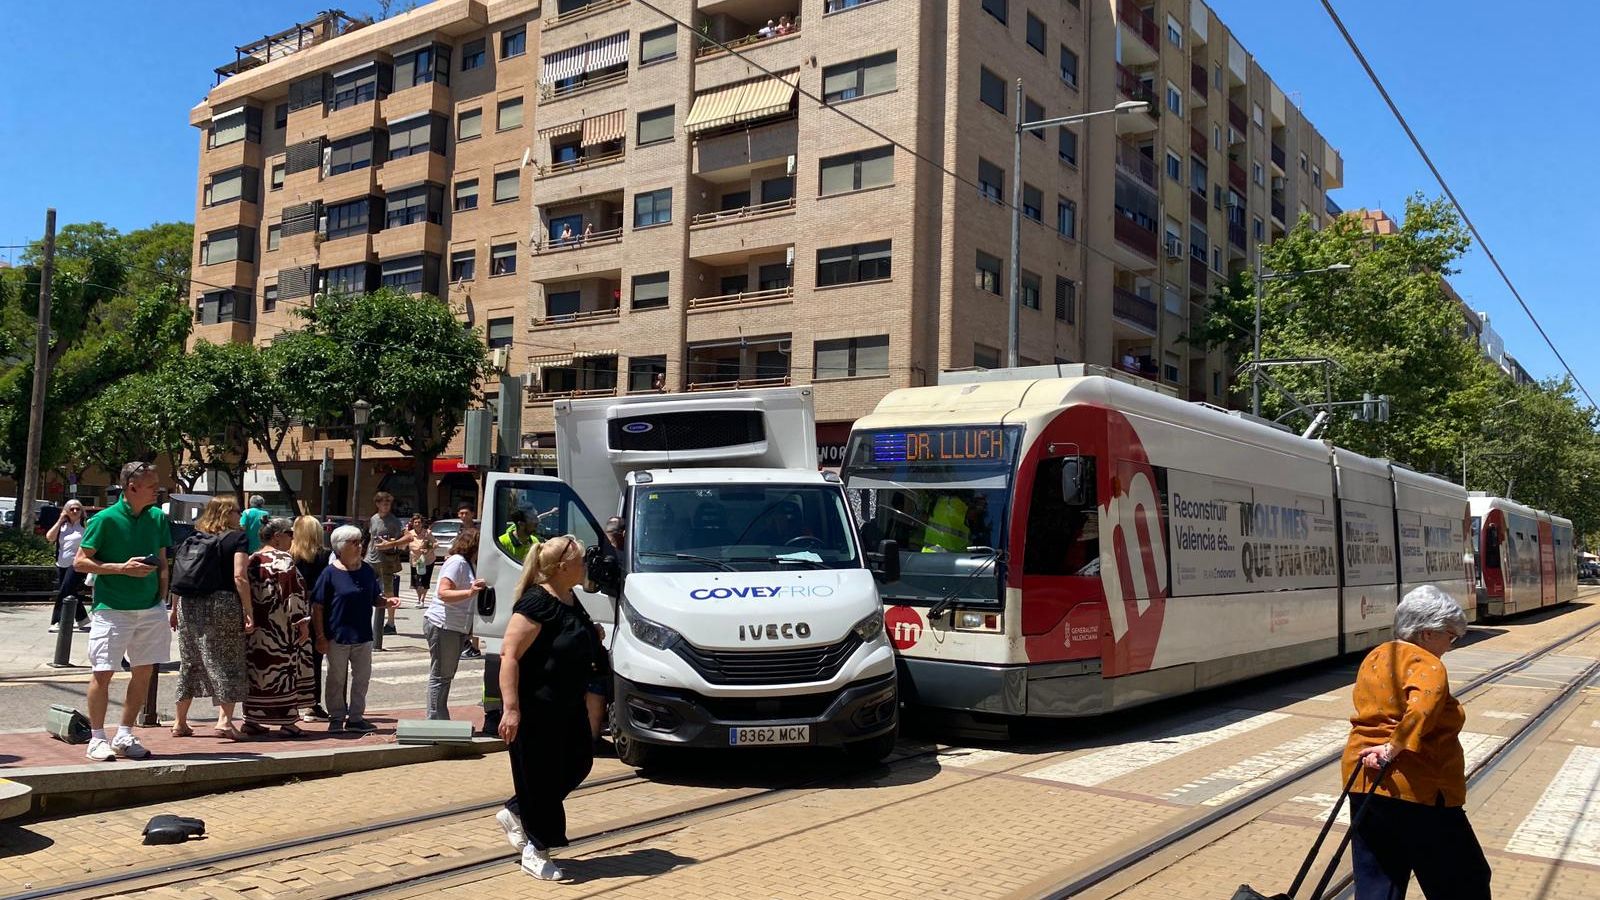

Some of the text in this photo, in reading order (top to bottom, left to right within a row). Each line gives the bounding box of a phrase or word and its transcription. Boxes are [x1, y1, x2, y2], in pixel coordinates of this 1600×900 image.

[907, 430, 1003, 461] DR. LLUCH
[1173, 492, 1227, 521] Reconstruir
[1240, 502, 1280, 538] MOLT
[1281, 506, 1309, 541] MÉS
[1175, 524, 1216, 551] València
[1241, 541, 1336, 583] QUE UNA OBRA
[739, 622, 812, 641] IVECO
[740, 728, 806, 742] 8362 MCK
